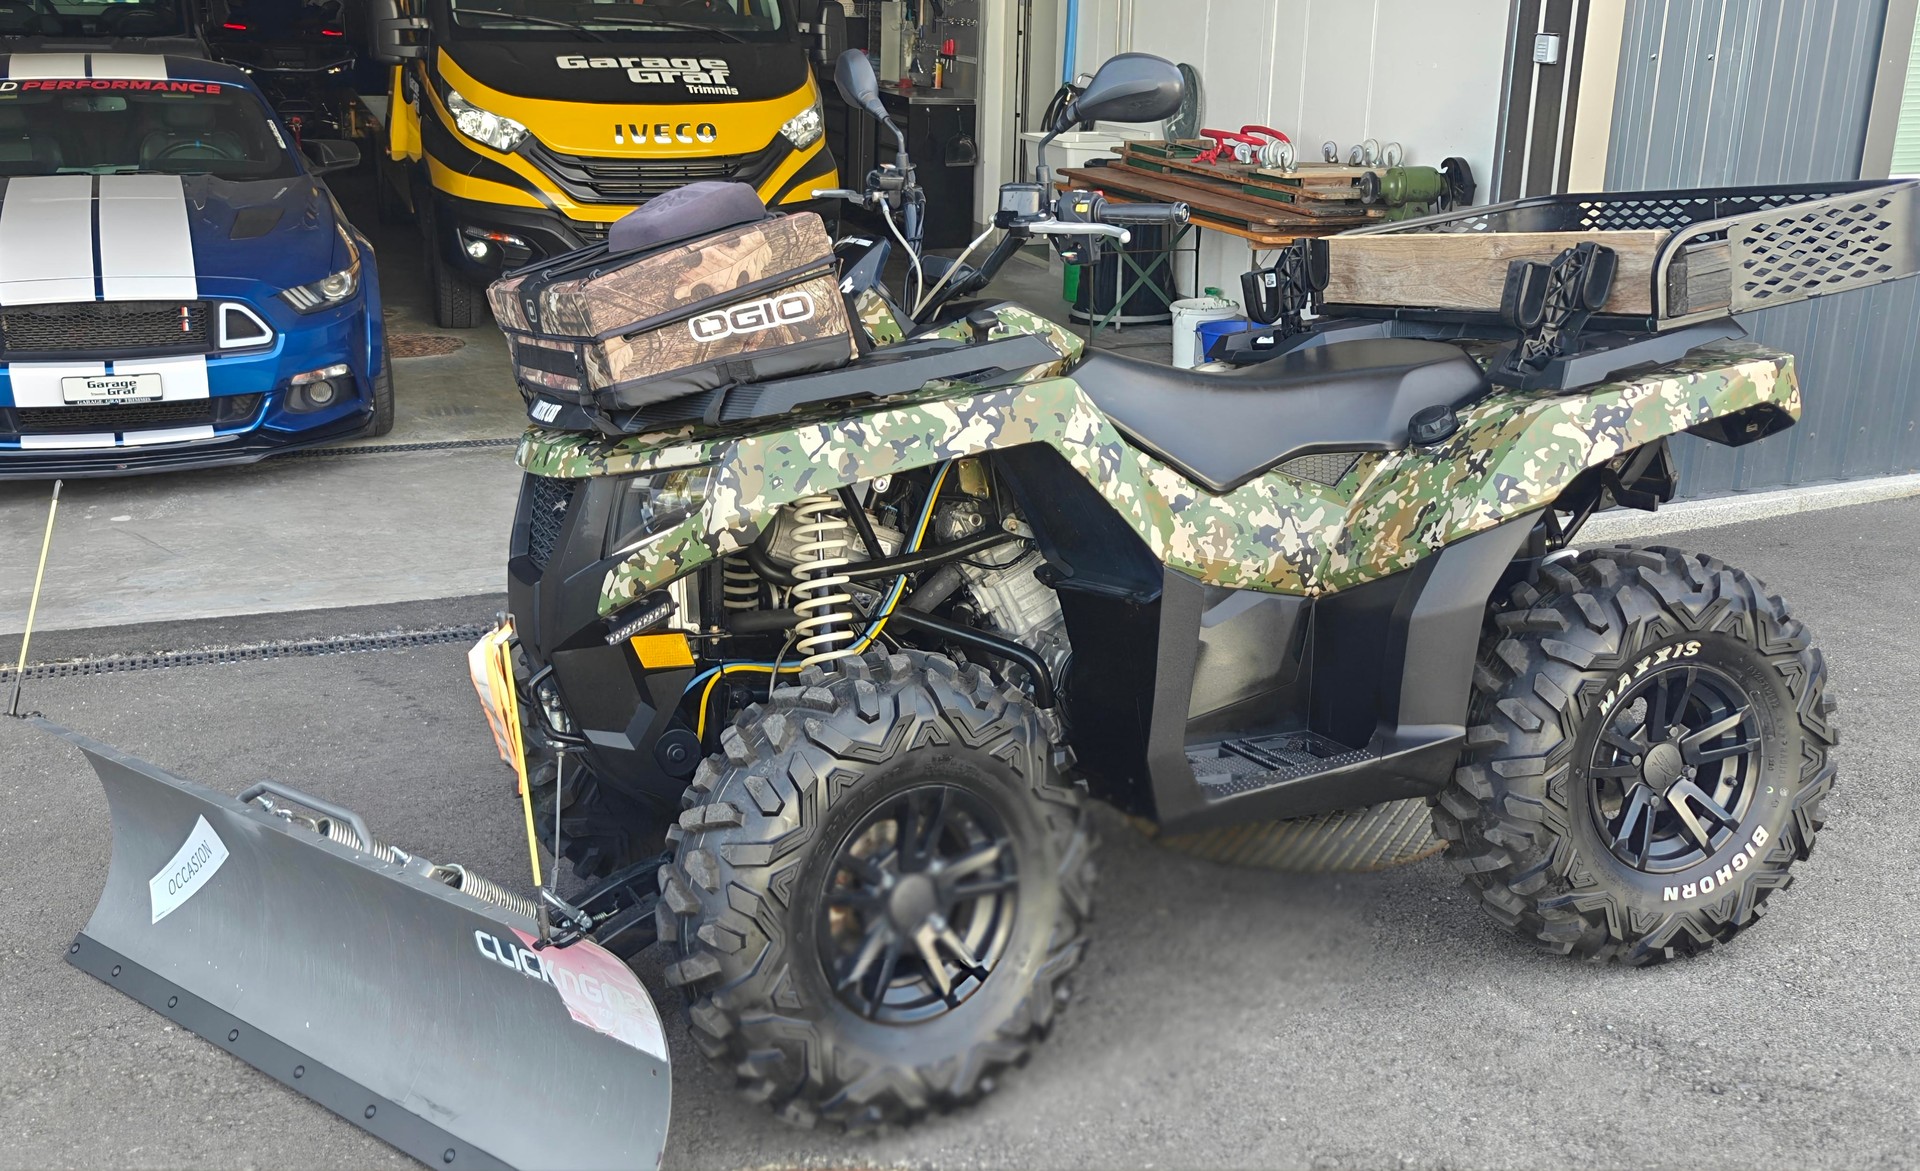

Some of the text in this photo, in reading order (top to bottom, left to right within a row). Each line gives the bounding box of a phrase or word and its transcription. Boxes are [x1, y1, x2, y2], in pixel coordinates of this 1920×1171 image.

[556, 55, 729, 71] Garage
[627, 68, 730, 84] Graf
[21, 80, 220, 94] PERFORMANCE
[686, 84, 739, 95] Trimmis
[614, 123, 717, 144] IVECO
[688, 291, 815, 342] OGIO
[87, 380, 137, 389] Garage
[107, 387, 137, 396] Graf
[1599, 640, 1702, 716] MAXXIS
[168, 839, 213, 896] OCCASION
[1663, 825, 1769, 901] BIGHORN
